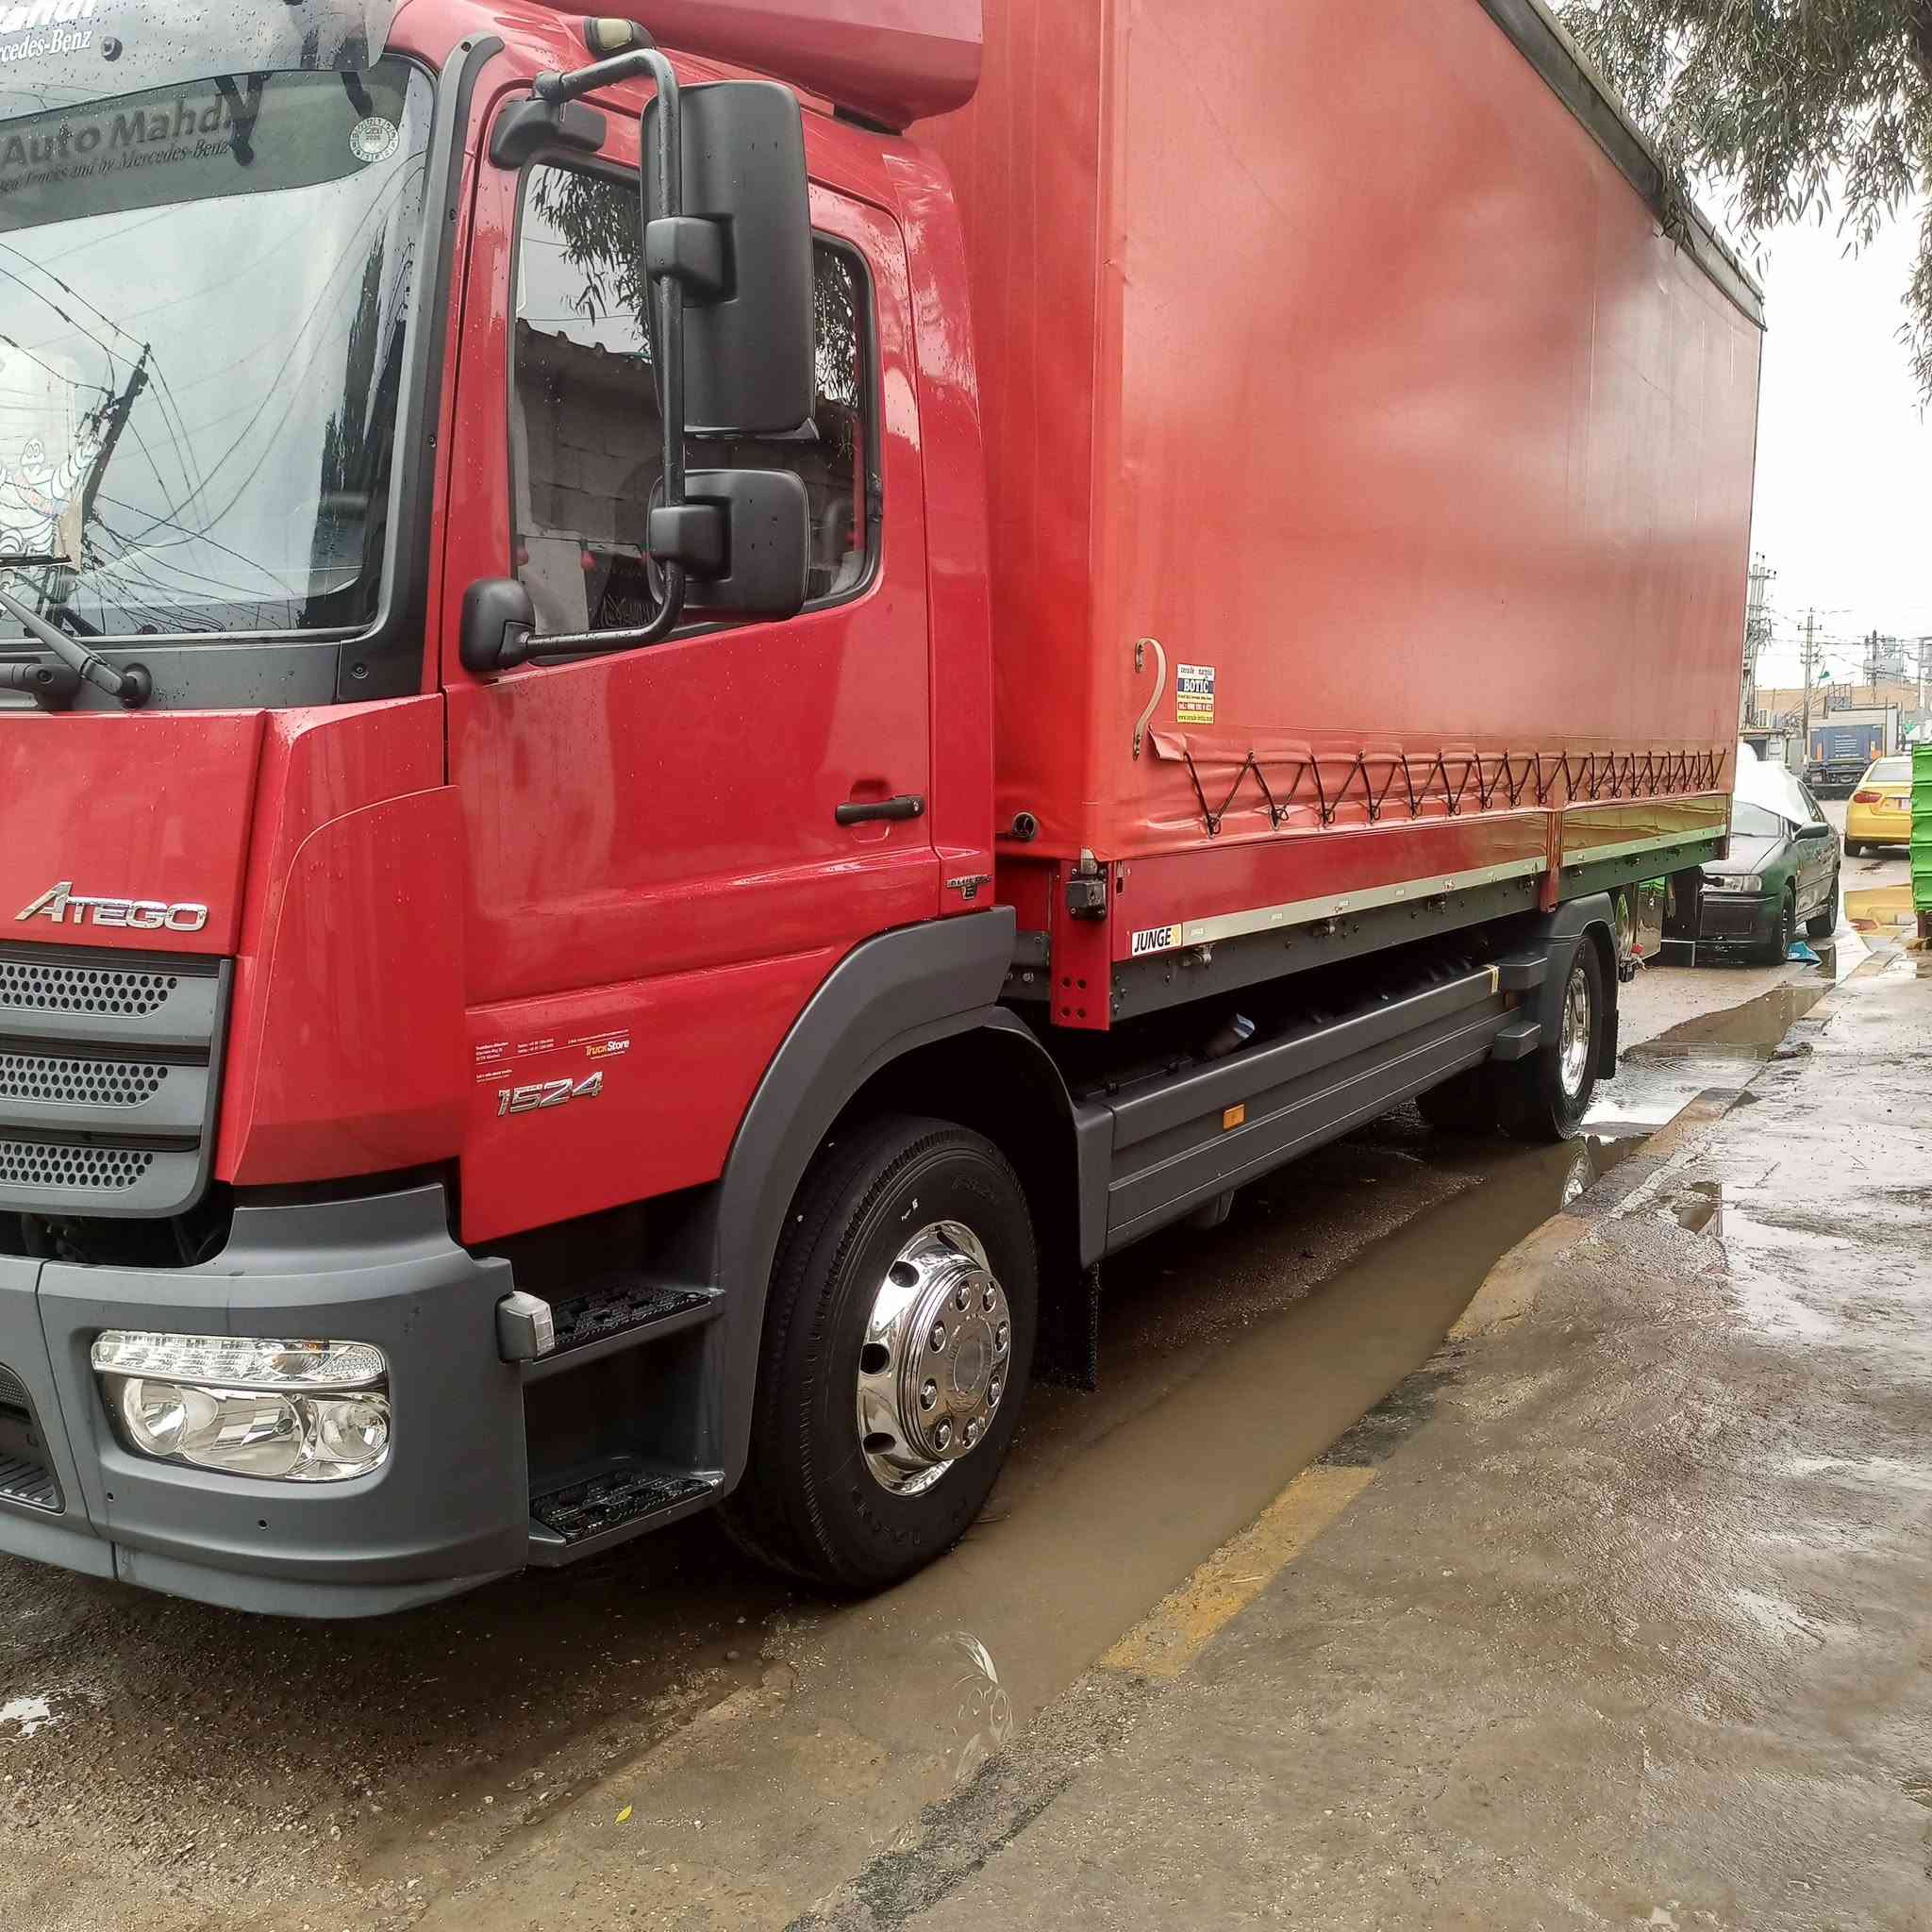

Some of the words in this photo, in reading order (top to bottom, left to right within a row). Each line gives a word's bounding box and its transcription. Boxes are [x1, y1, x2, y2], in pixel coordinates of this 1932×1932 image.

[14, 881, 208, 932] ATEGO
[1134, 927, 1172, 952] JUNGE
[497, 1071, 604, 1117] 1524
